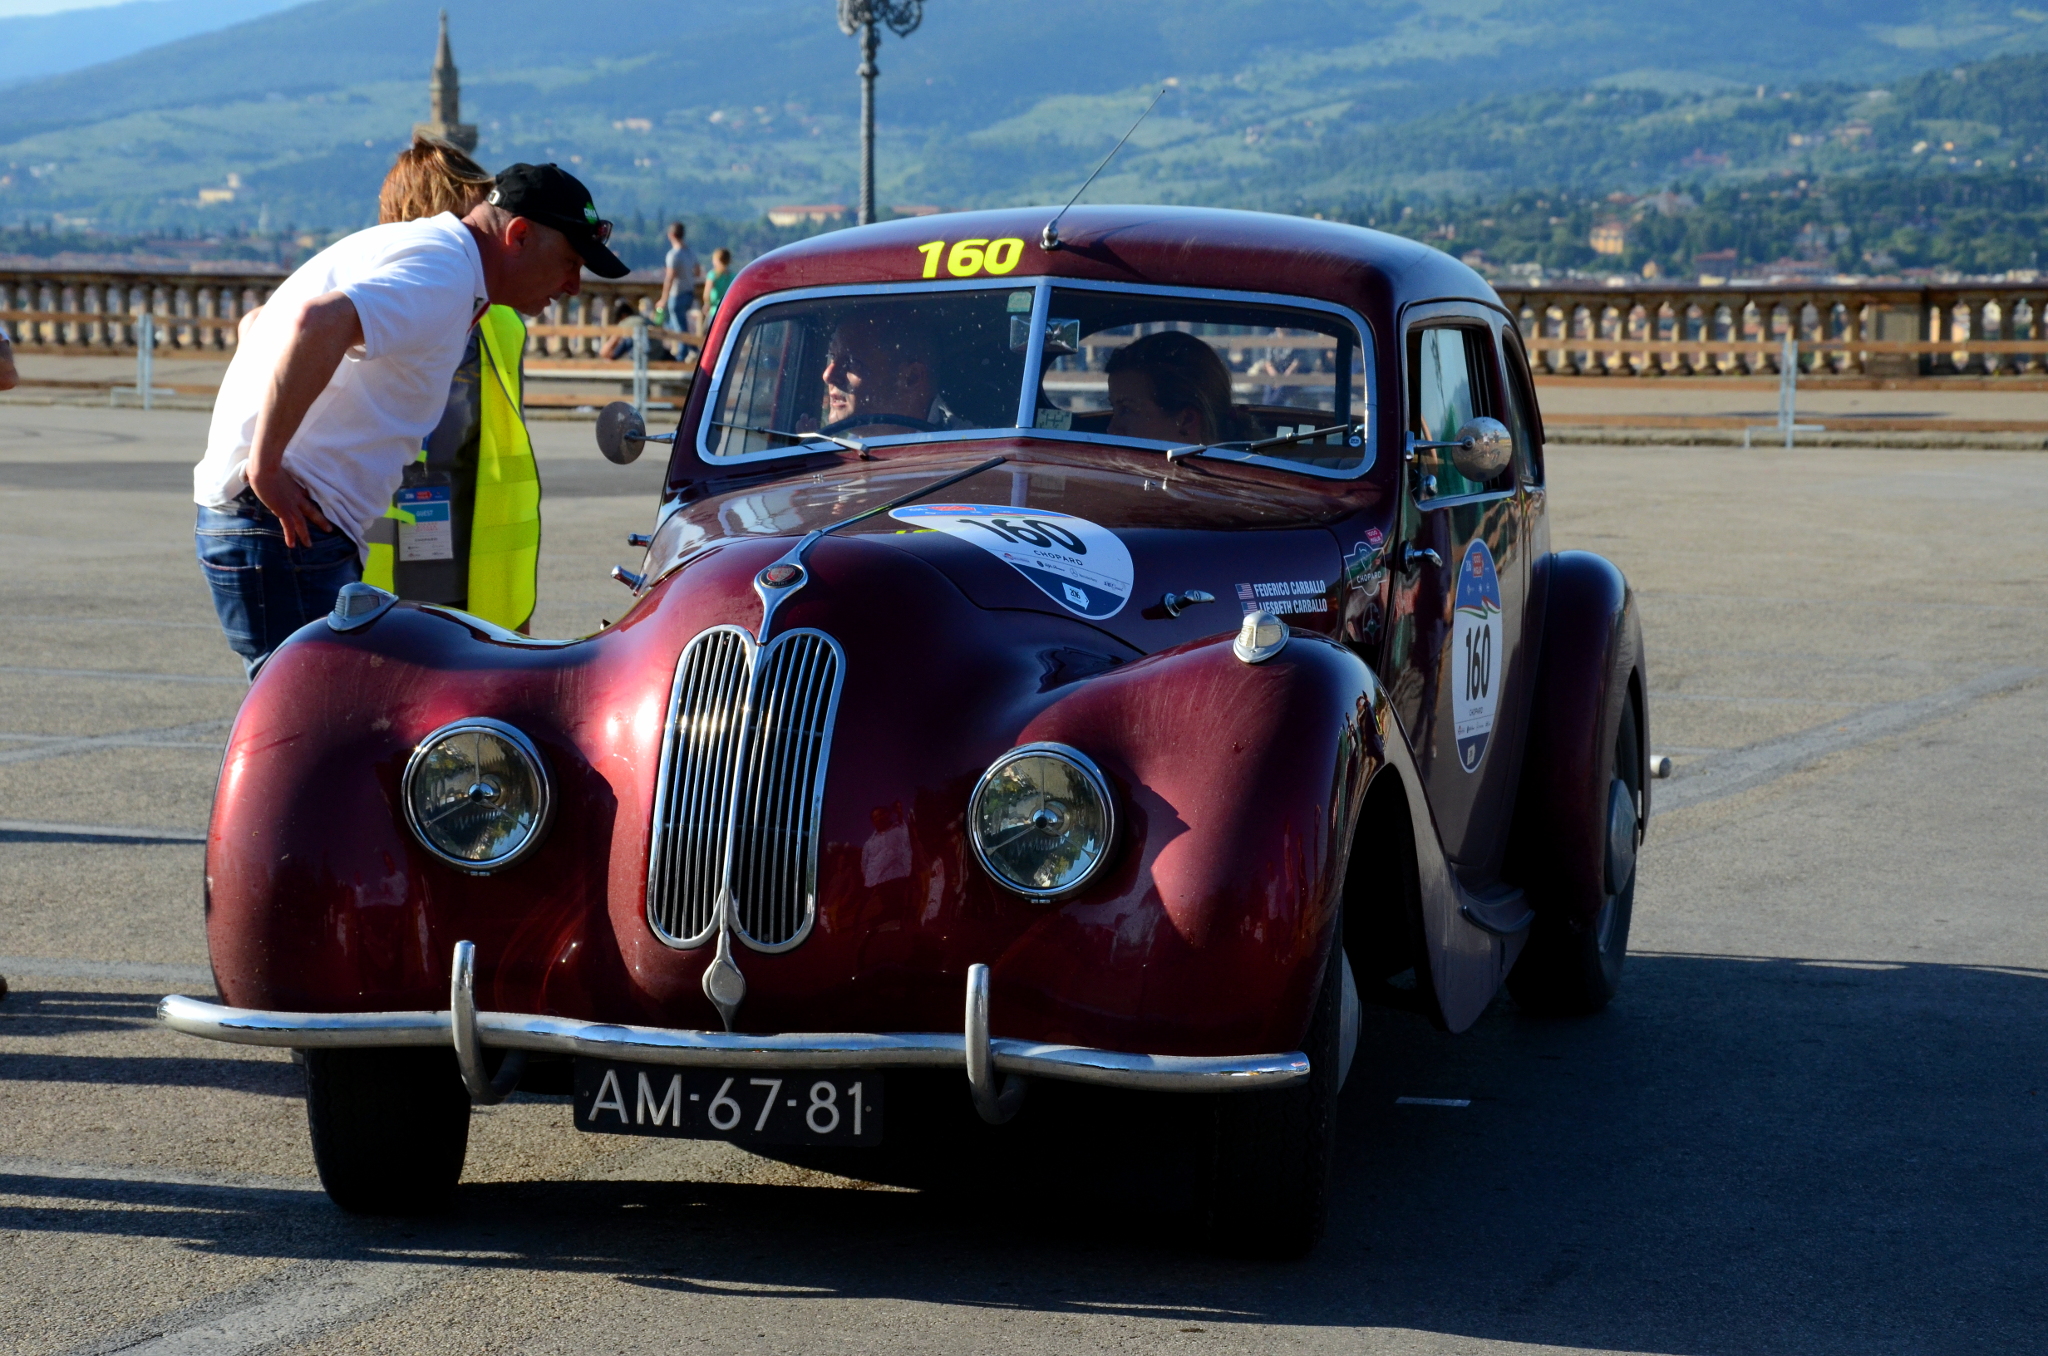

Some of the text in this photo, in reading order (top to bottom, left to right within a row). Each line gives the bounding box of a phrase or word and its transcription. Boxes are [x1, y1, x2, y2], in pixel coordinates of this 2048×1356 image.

[918, 238, 1025, 278] 160
[956, 519, 1088, 555] 160
[1033, 549, 1084, 566] CHOPARD
[1253, 579, 1326, 597] FEDERICO CARBALLO
[1356, 571, 1382, 583] CHOPARD
[1293, 598, 1328, 613] CARBALLO
[1466, 624, 1491, 702] 160
[588, 1069, 863, 1136] AM-67-81
